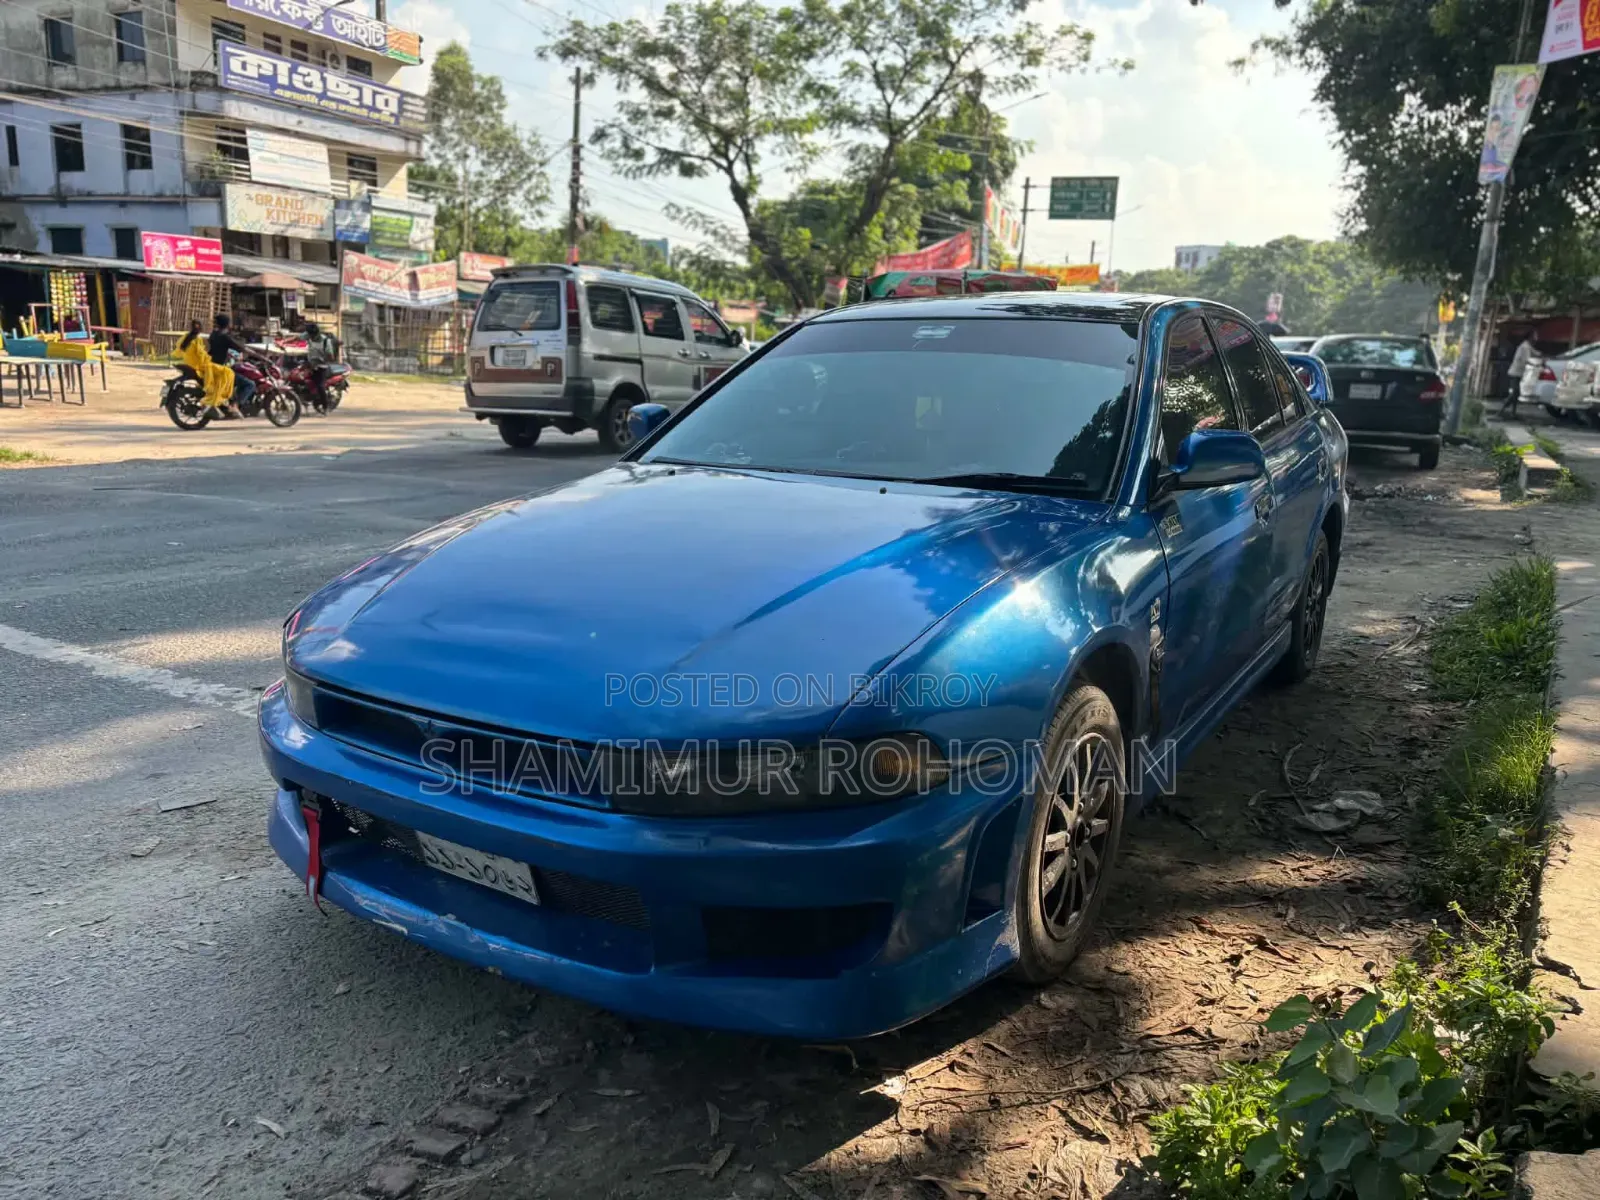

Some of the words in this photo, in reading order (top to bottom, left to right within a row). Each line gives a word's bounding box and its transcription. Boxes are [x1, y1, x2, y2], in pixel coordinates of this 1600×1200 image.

[226, 47, 400, 115] কাওছার
[255, 193, 305, 210] GRAND
[265, 208, 324, 226] KITCHEN
